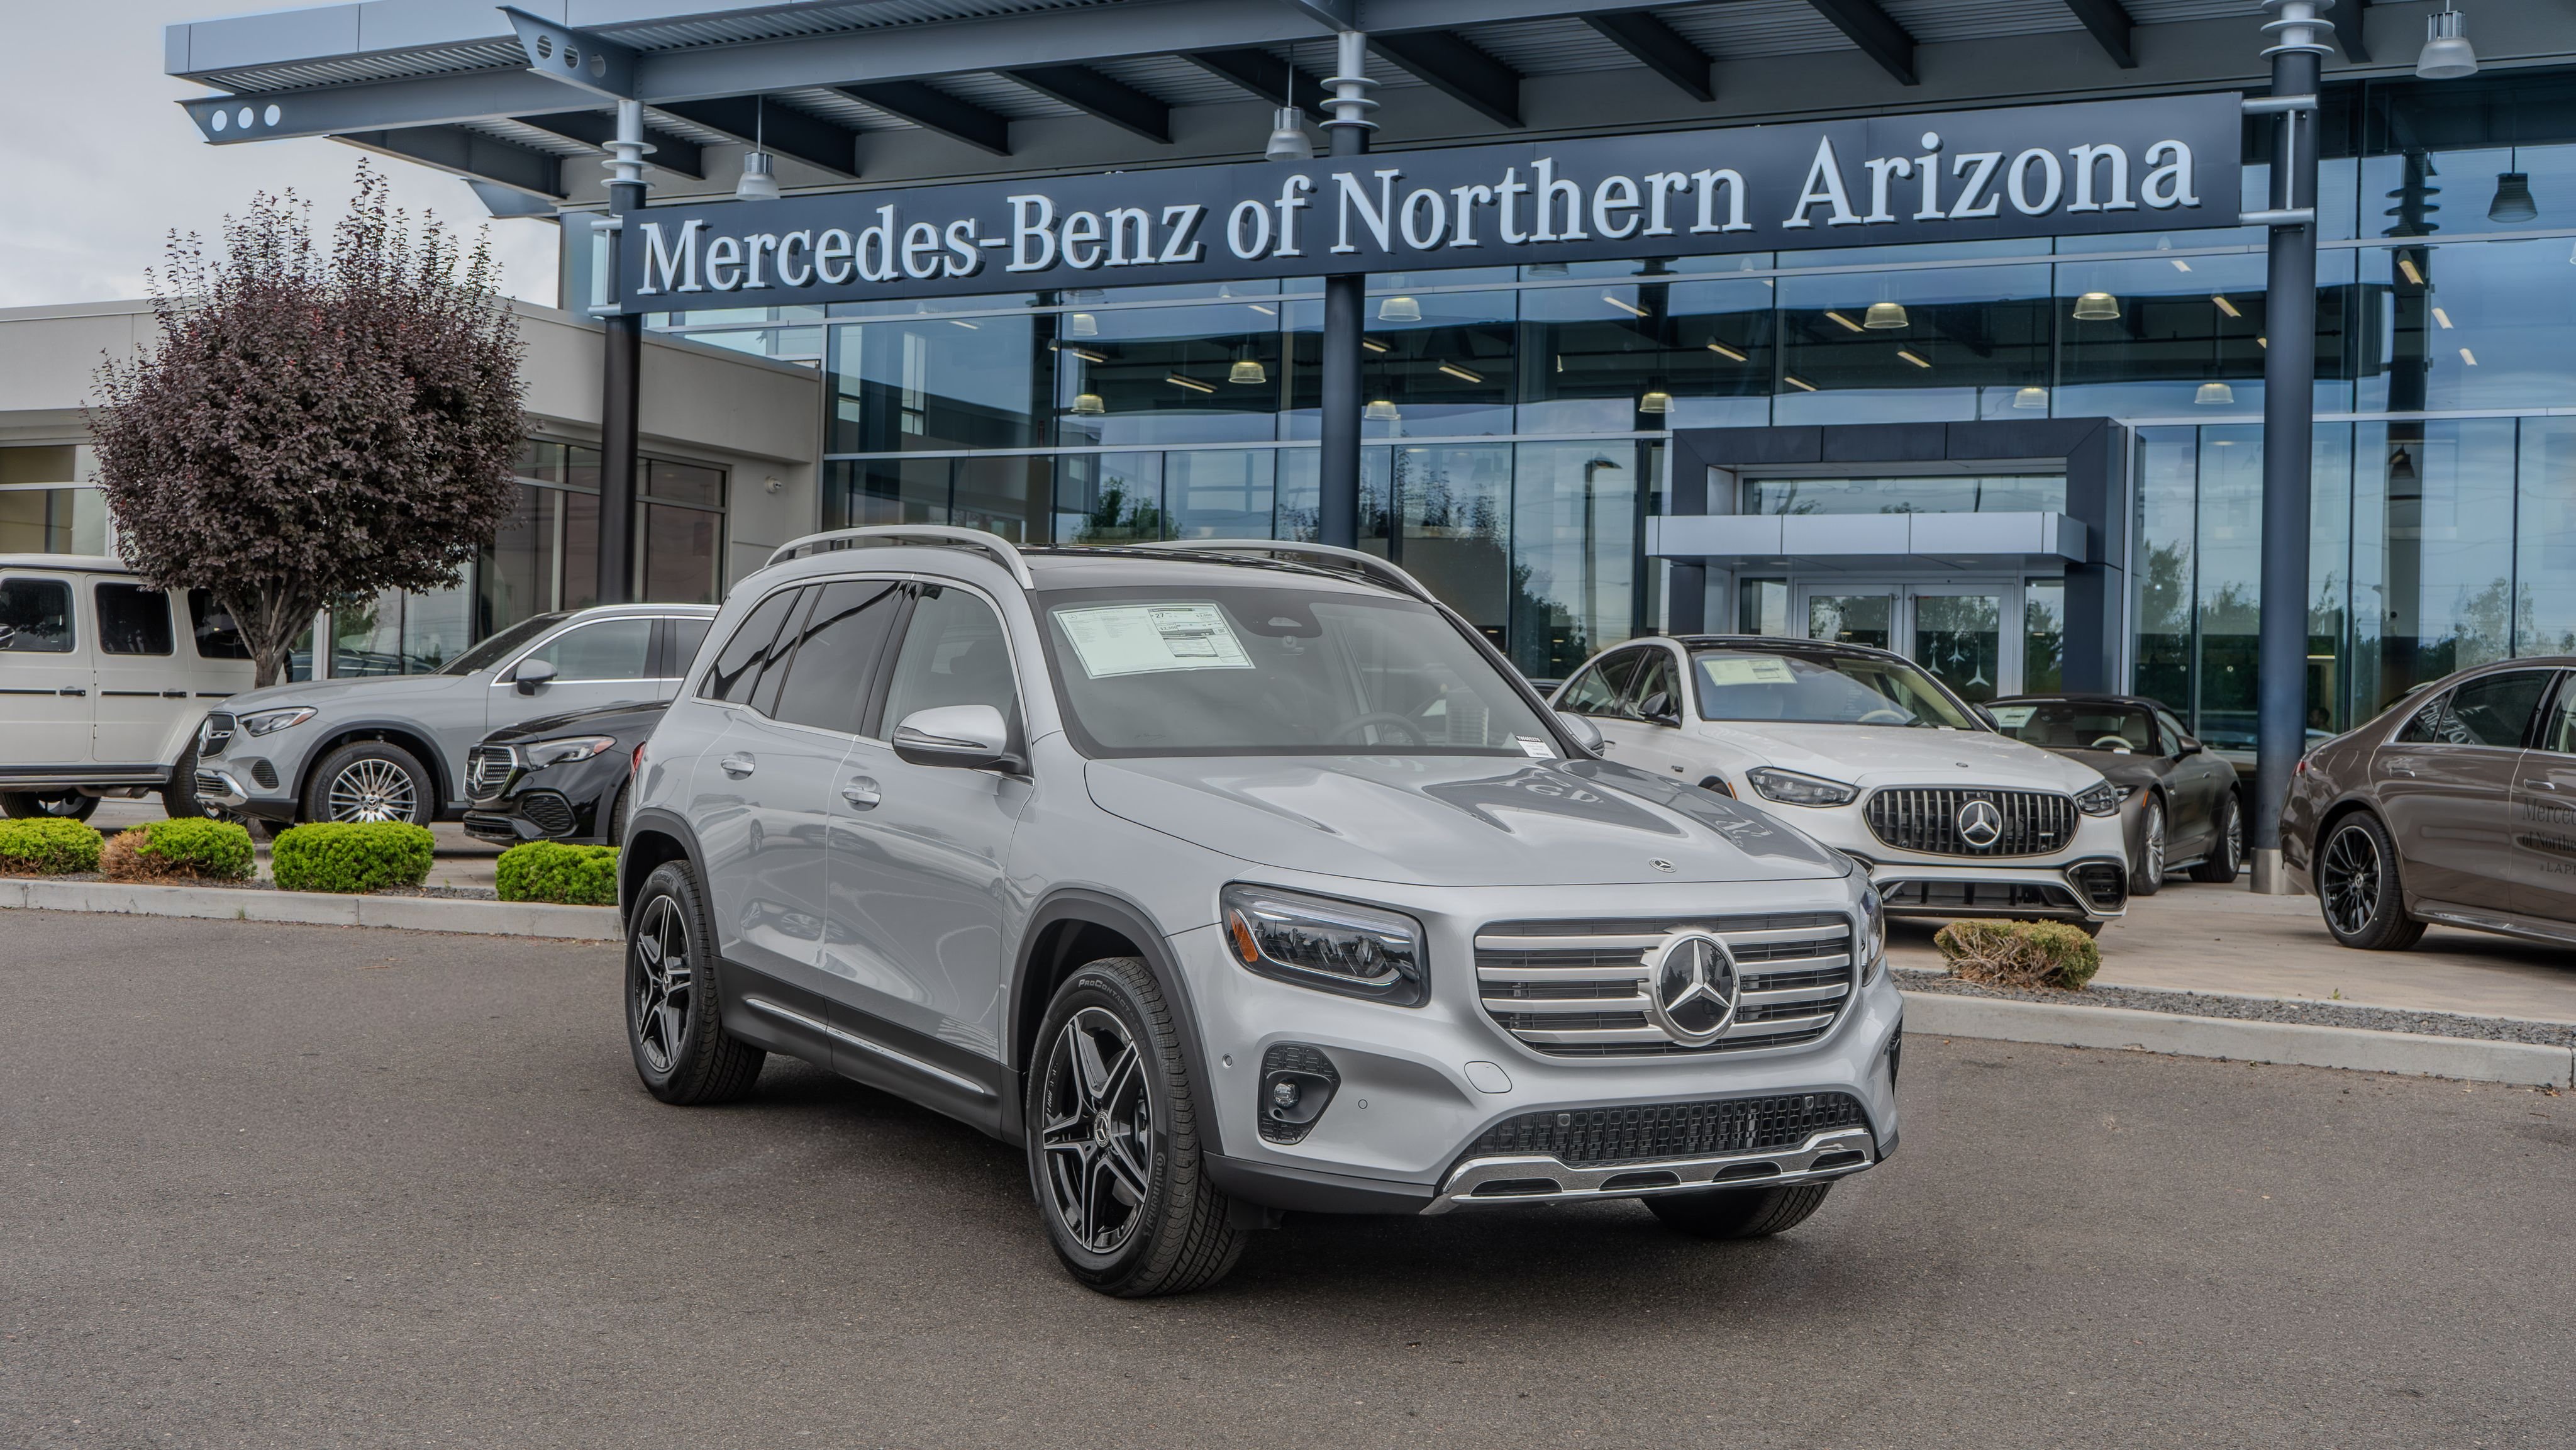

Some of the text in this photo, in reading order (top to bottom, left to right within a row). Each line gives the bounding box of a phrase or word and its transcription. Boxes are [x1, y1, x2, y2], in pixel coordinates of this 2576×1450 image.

[636, 132, 2199, 296] Mercedes-Benz of Northern Arizona
